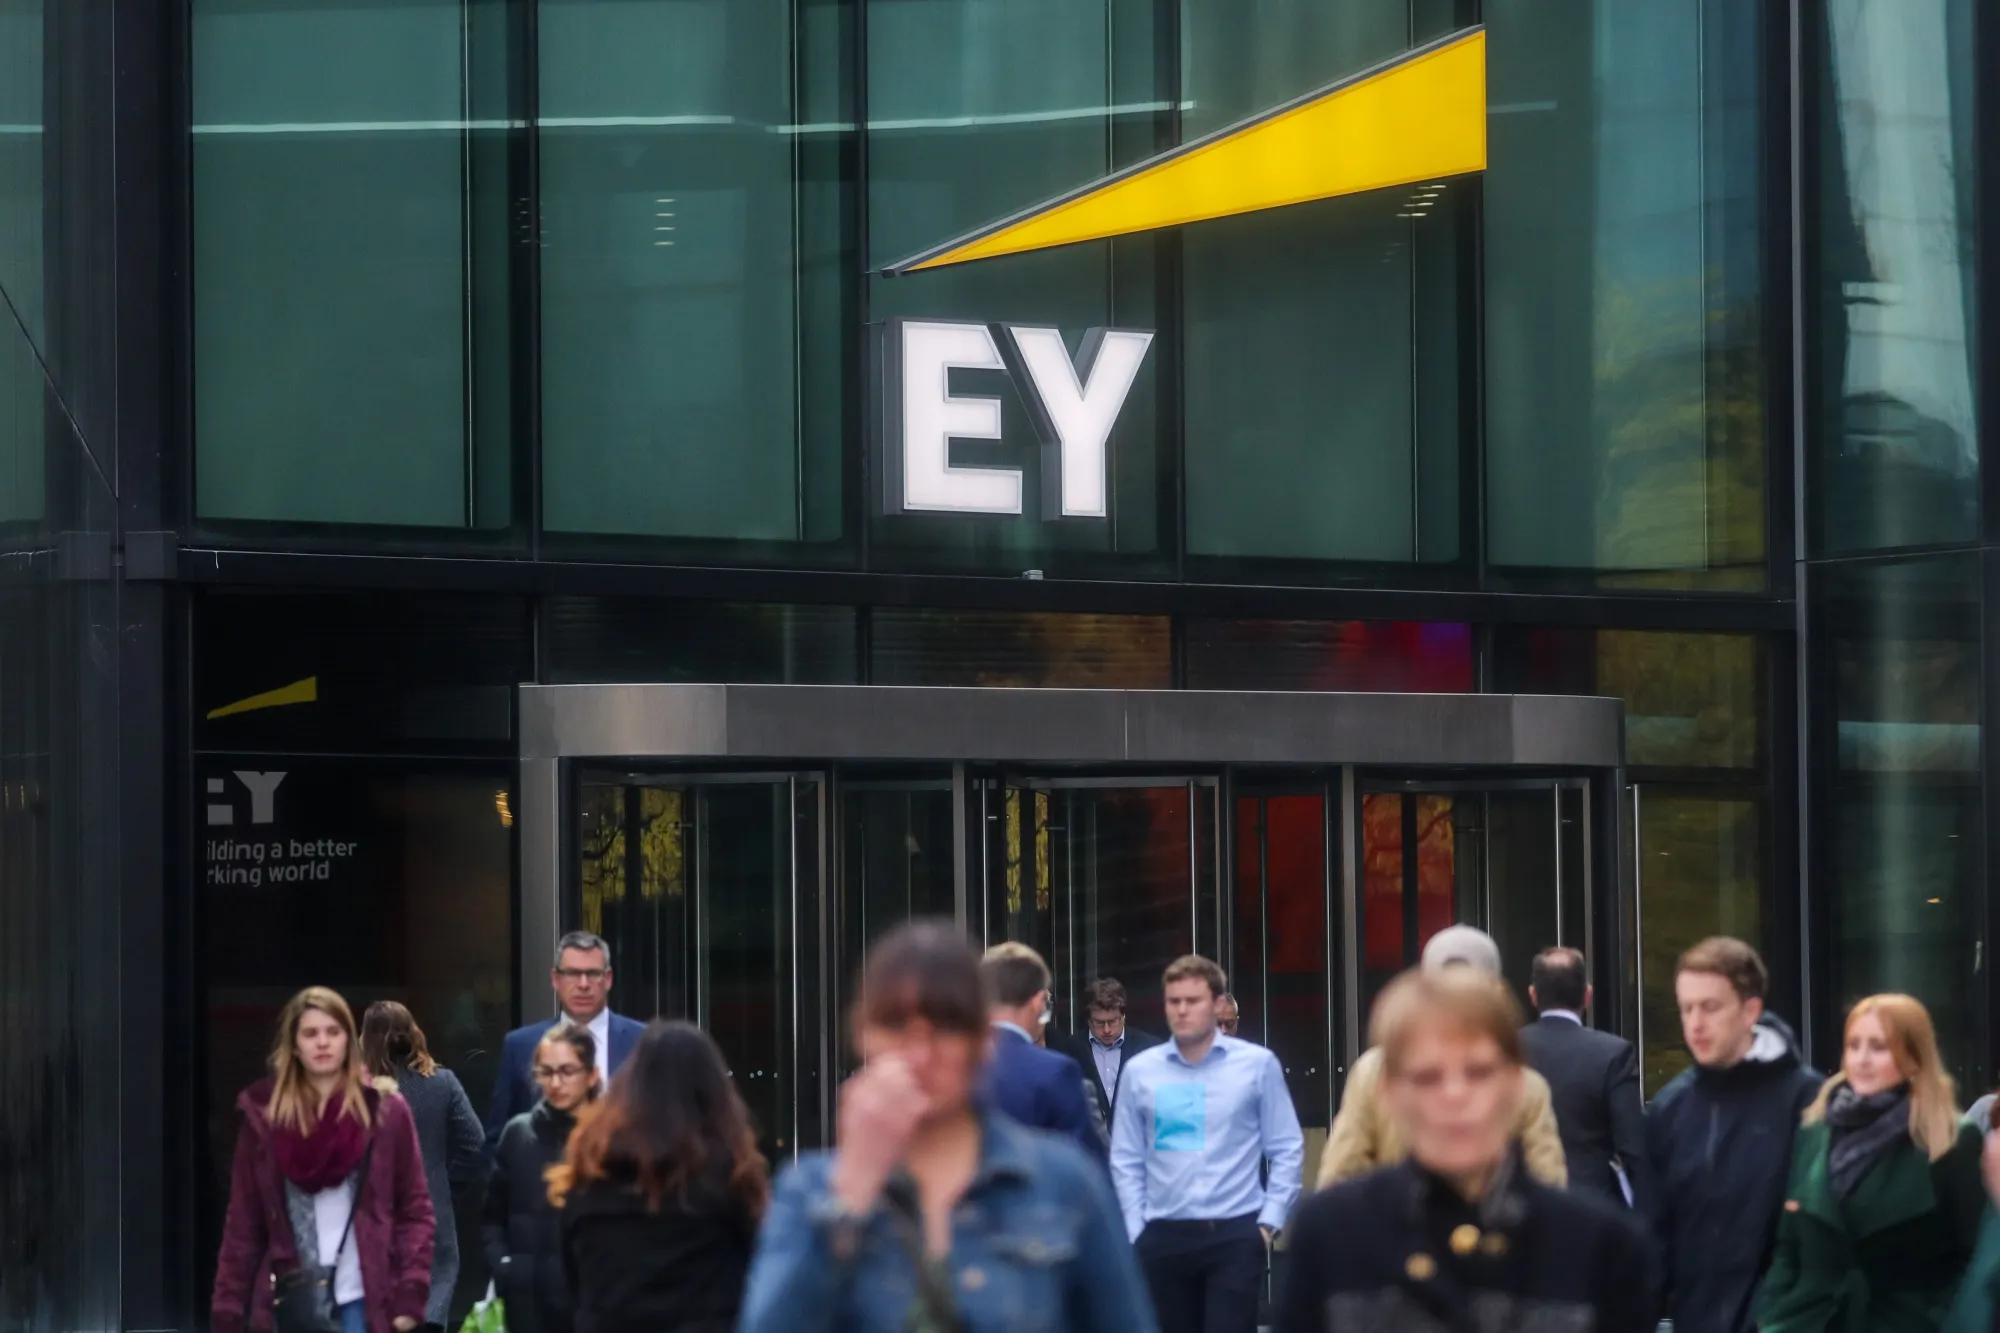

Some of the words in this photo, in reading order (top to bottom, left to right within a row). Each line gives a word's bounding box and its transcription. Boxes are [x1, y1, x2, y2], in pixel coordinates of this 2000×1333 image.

[902, 320, 1155, 517] EY
[270, 842, 282, 858] a
[289, 839, 357, 857] better
[268, 860, 330, 882] world
